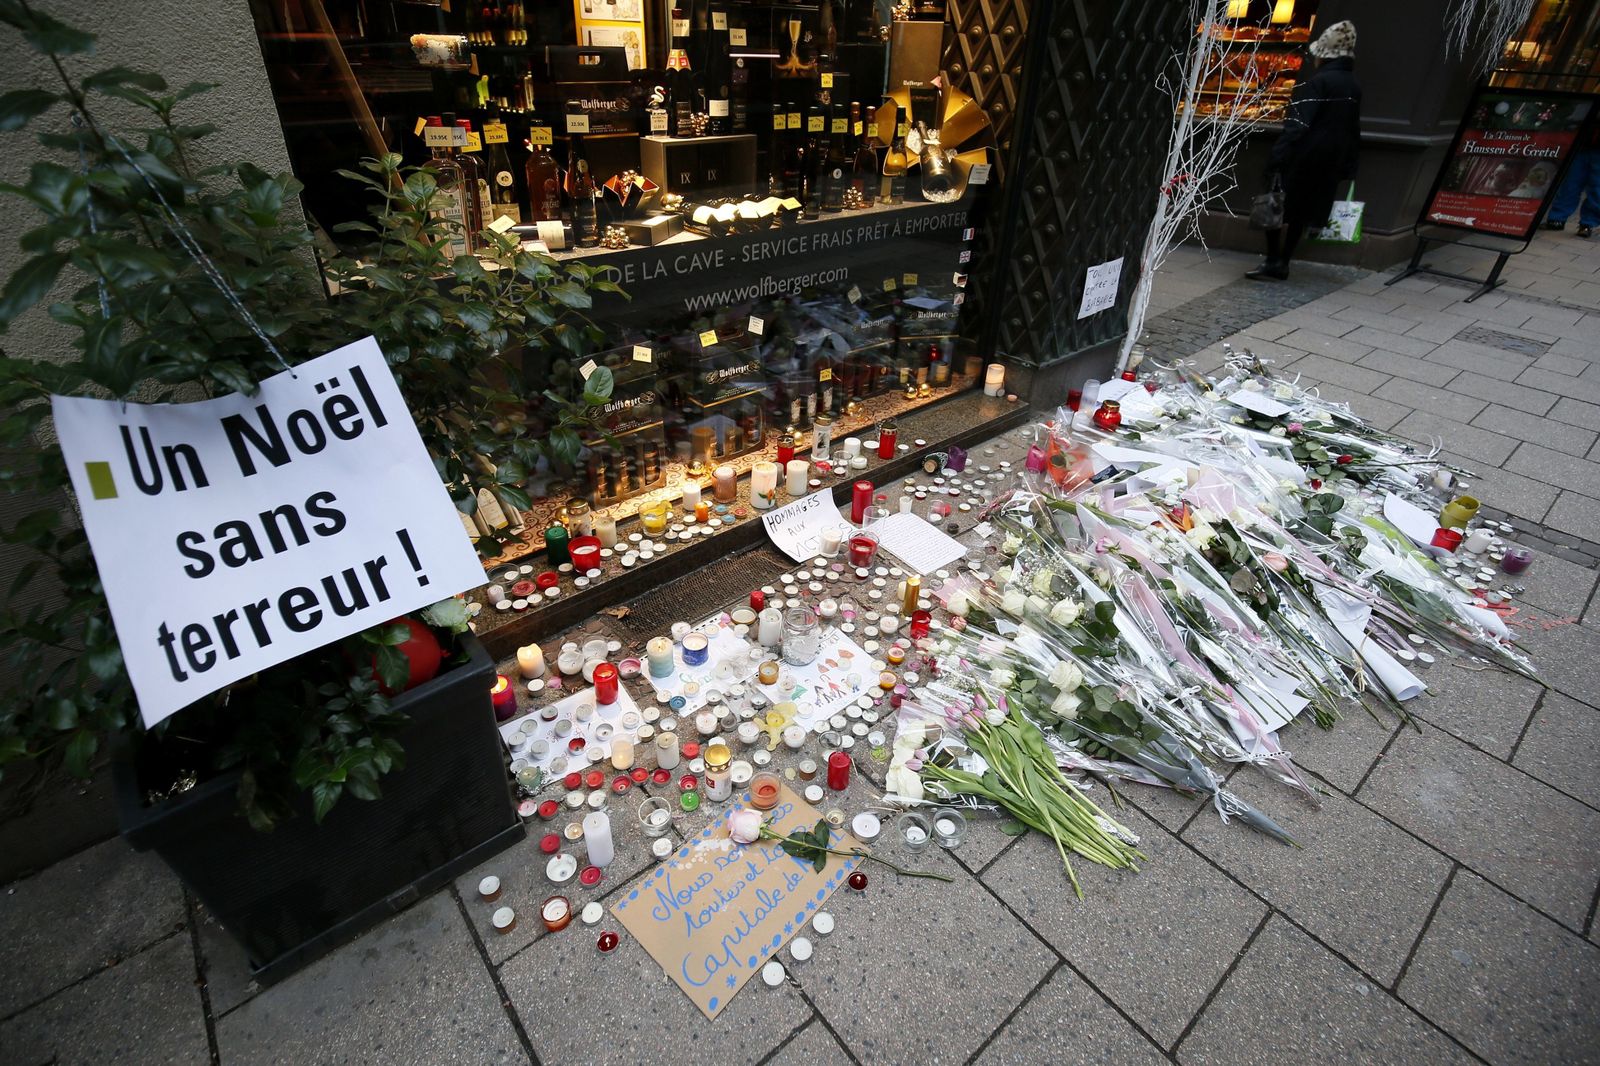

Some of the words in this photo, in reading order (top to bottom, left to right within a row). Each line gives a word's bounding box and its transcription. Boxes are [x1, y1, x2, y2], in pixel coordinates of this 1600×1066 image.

[581, 98, 616, 110] Wolfberger
[1508, 142, 1520, 155] &
[1522, 142, 1561, 158] Gretel
[607, 263, 636, 285] DE
[642, 259, 668, 280] LA
[674, 250, 724, 274] CAVE
[742, 235, 808, 262] SERVICE
[812, 228, 852, 251] FRAIS
[857, 221, 889, 243] PRÊT
[892, 218, 901, 237] À
[905, 211, 967, 236] EMPORTER
[684, 266, 849, 312] www.wolfberger.com
[719, 364, 750, 378] Wolfberger
[119, 424, 210, 496] Un
[220, 365, 389, 477] Noël
[176, 491, 347, 579] sans
[766, 494, 821, 534] HOMMAGES
[788, 520, 807, 536] AUX
[157, 555, 391, 682] terreur
[396, 528, 430, 587] !
[745, 860, 765, 882] et
[652, 872, 714, 921] Nous
[682, 888, 786, 987] Capitale
[783, 872, 804, 893] de
